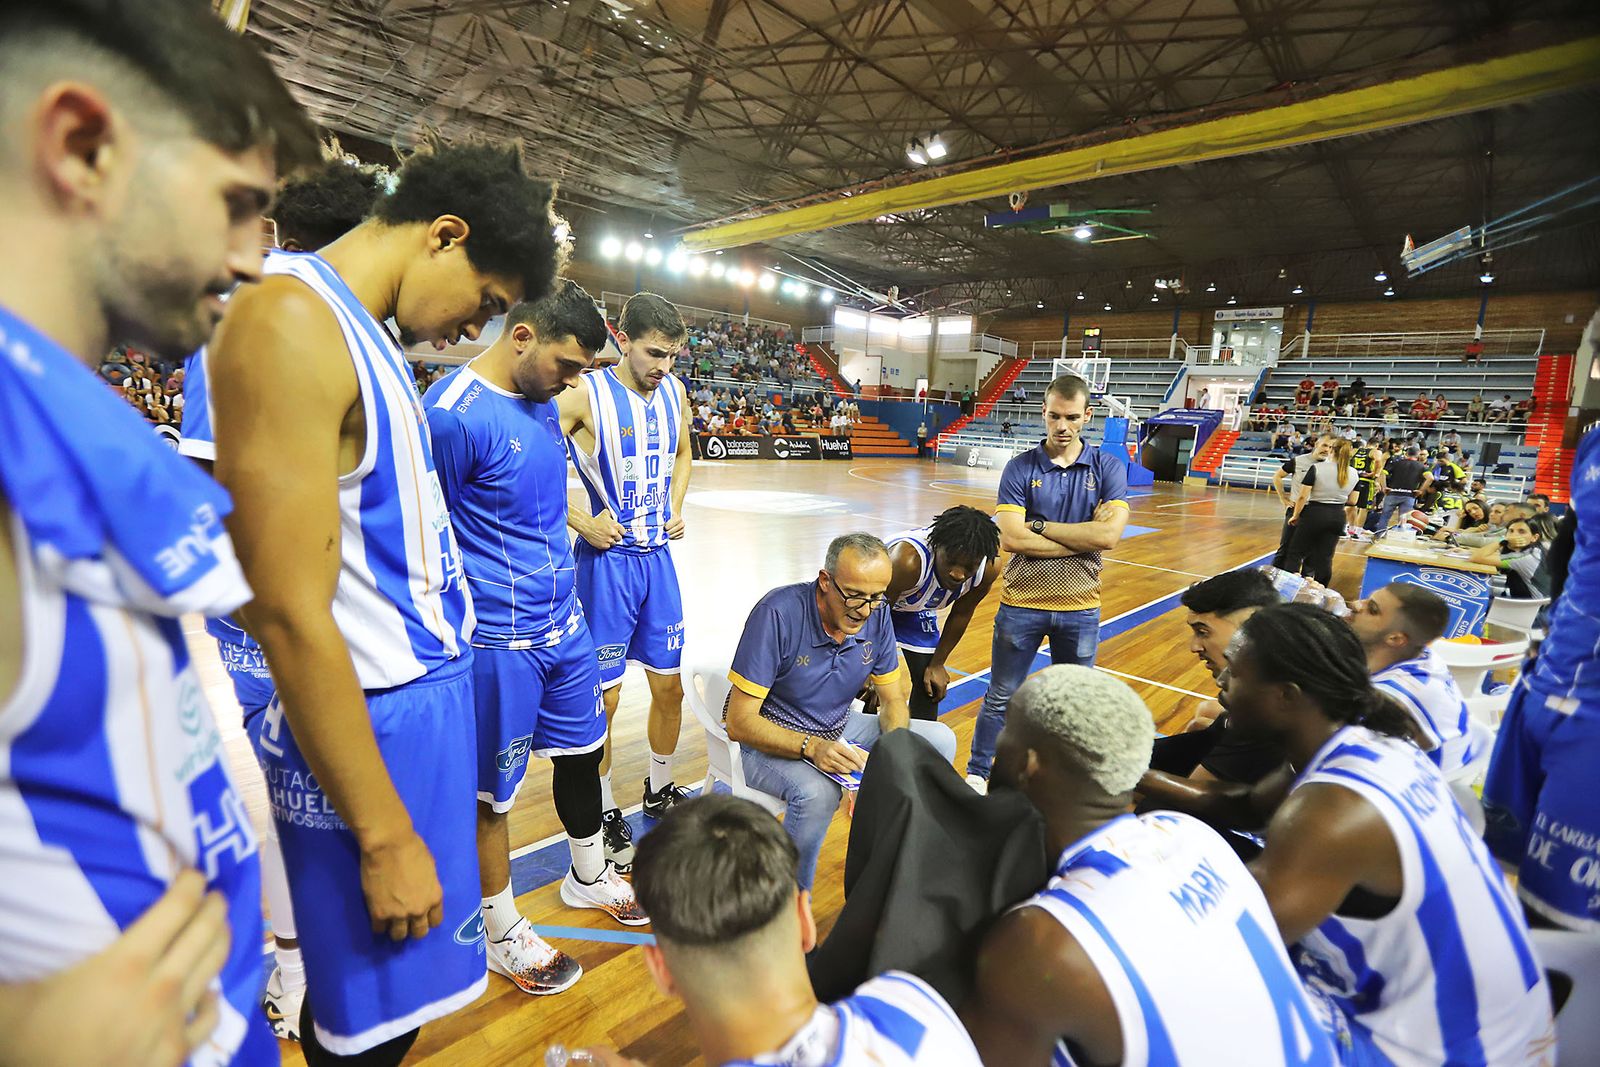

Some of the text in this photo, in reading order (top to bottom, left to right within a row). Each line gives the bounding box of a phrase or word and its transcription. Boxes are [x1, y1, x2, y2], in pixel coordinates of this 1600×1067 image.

[821, 439, 850, 451] Huelva
[645, 455, 660, 479] 10
[1443, 497, 1463, 510] 34
[598, 647, 623, 660] Ford
[1169, 857, 1229, 926] MARX
